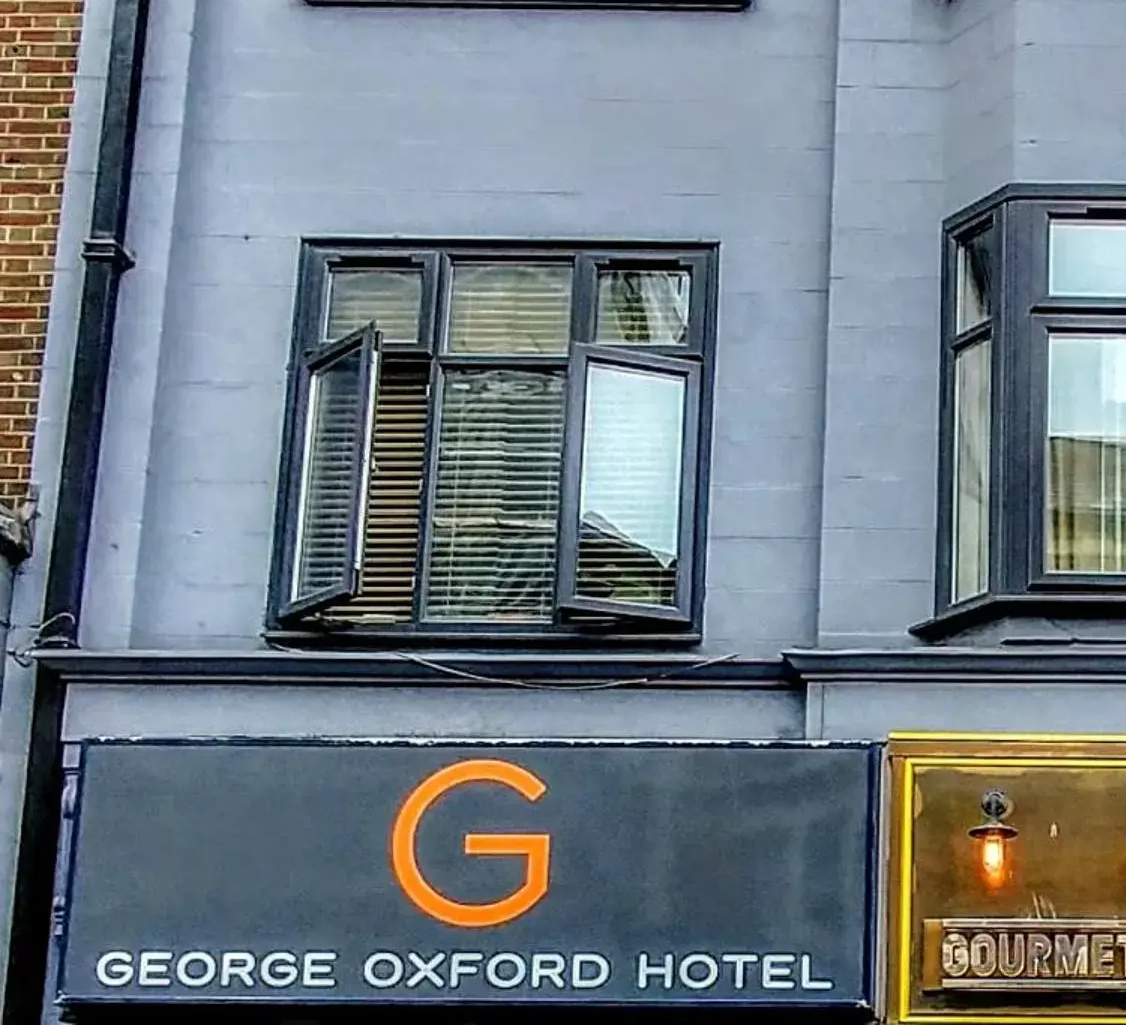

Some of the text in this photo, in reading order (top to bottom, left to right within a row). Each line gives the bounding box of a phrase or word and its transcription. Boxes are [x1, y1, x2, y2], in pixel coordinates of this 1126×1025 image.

[391, 759, 550, 927] G
[95, 951, 834, 989] GEORGE OXFORD HOTEL
